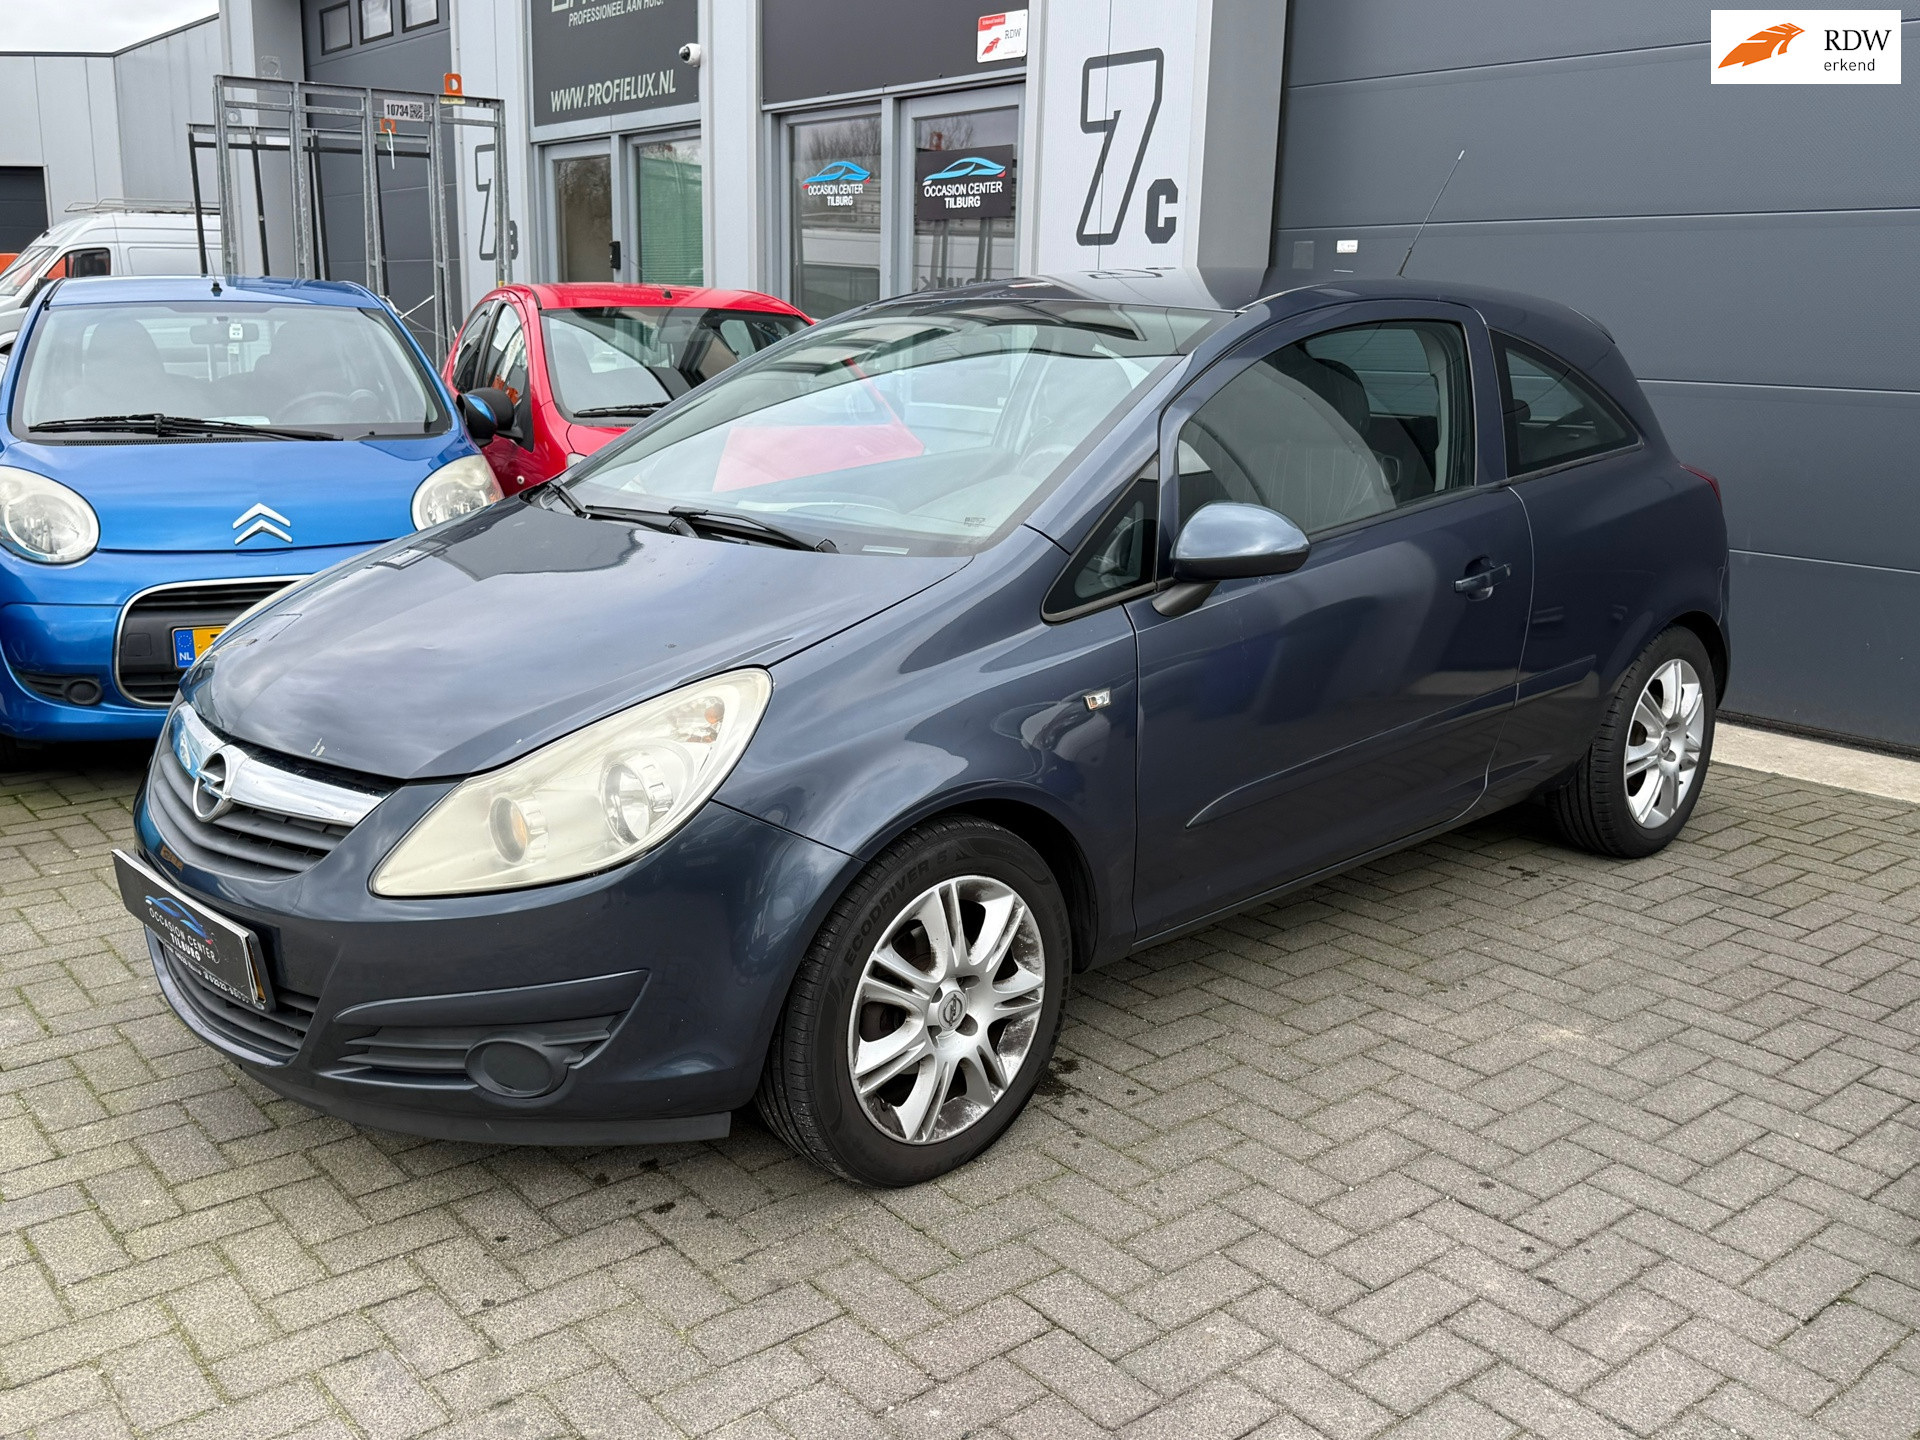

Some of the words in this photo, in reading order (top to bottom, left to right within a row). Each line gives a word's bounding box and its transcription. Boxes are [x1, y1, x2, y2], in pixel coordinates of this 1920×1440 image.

[568, 1, 625, 27] PROFESSIONEEL
[626, 0, 642, 13] AAN
[1004, 28, 1021, 39] RDW
[551, 69, 676, 112] WWW.PROFIELUX.NL
[386, 104, 409, 117] 10734
[1076, 47, 1164, 246] 7
[808, 184, 838, 196] OCCASION
[838, 184, 864, 195] CENTER
[924, 184, 967, 198] OCCASION
[968, 181, 1003, 195] CENTER
[827, 196, 853, 206] TILBURG
[944, 196, 981, 209] TILBURG
[179, 651, 193, 661] NL
[149, 907, 186, 941] OCCASION
[187, 935, 216, 961] CENTER
[169, 932, 201, 962] TILBURG
